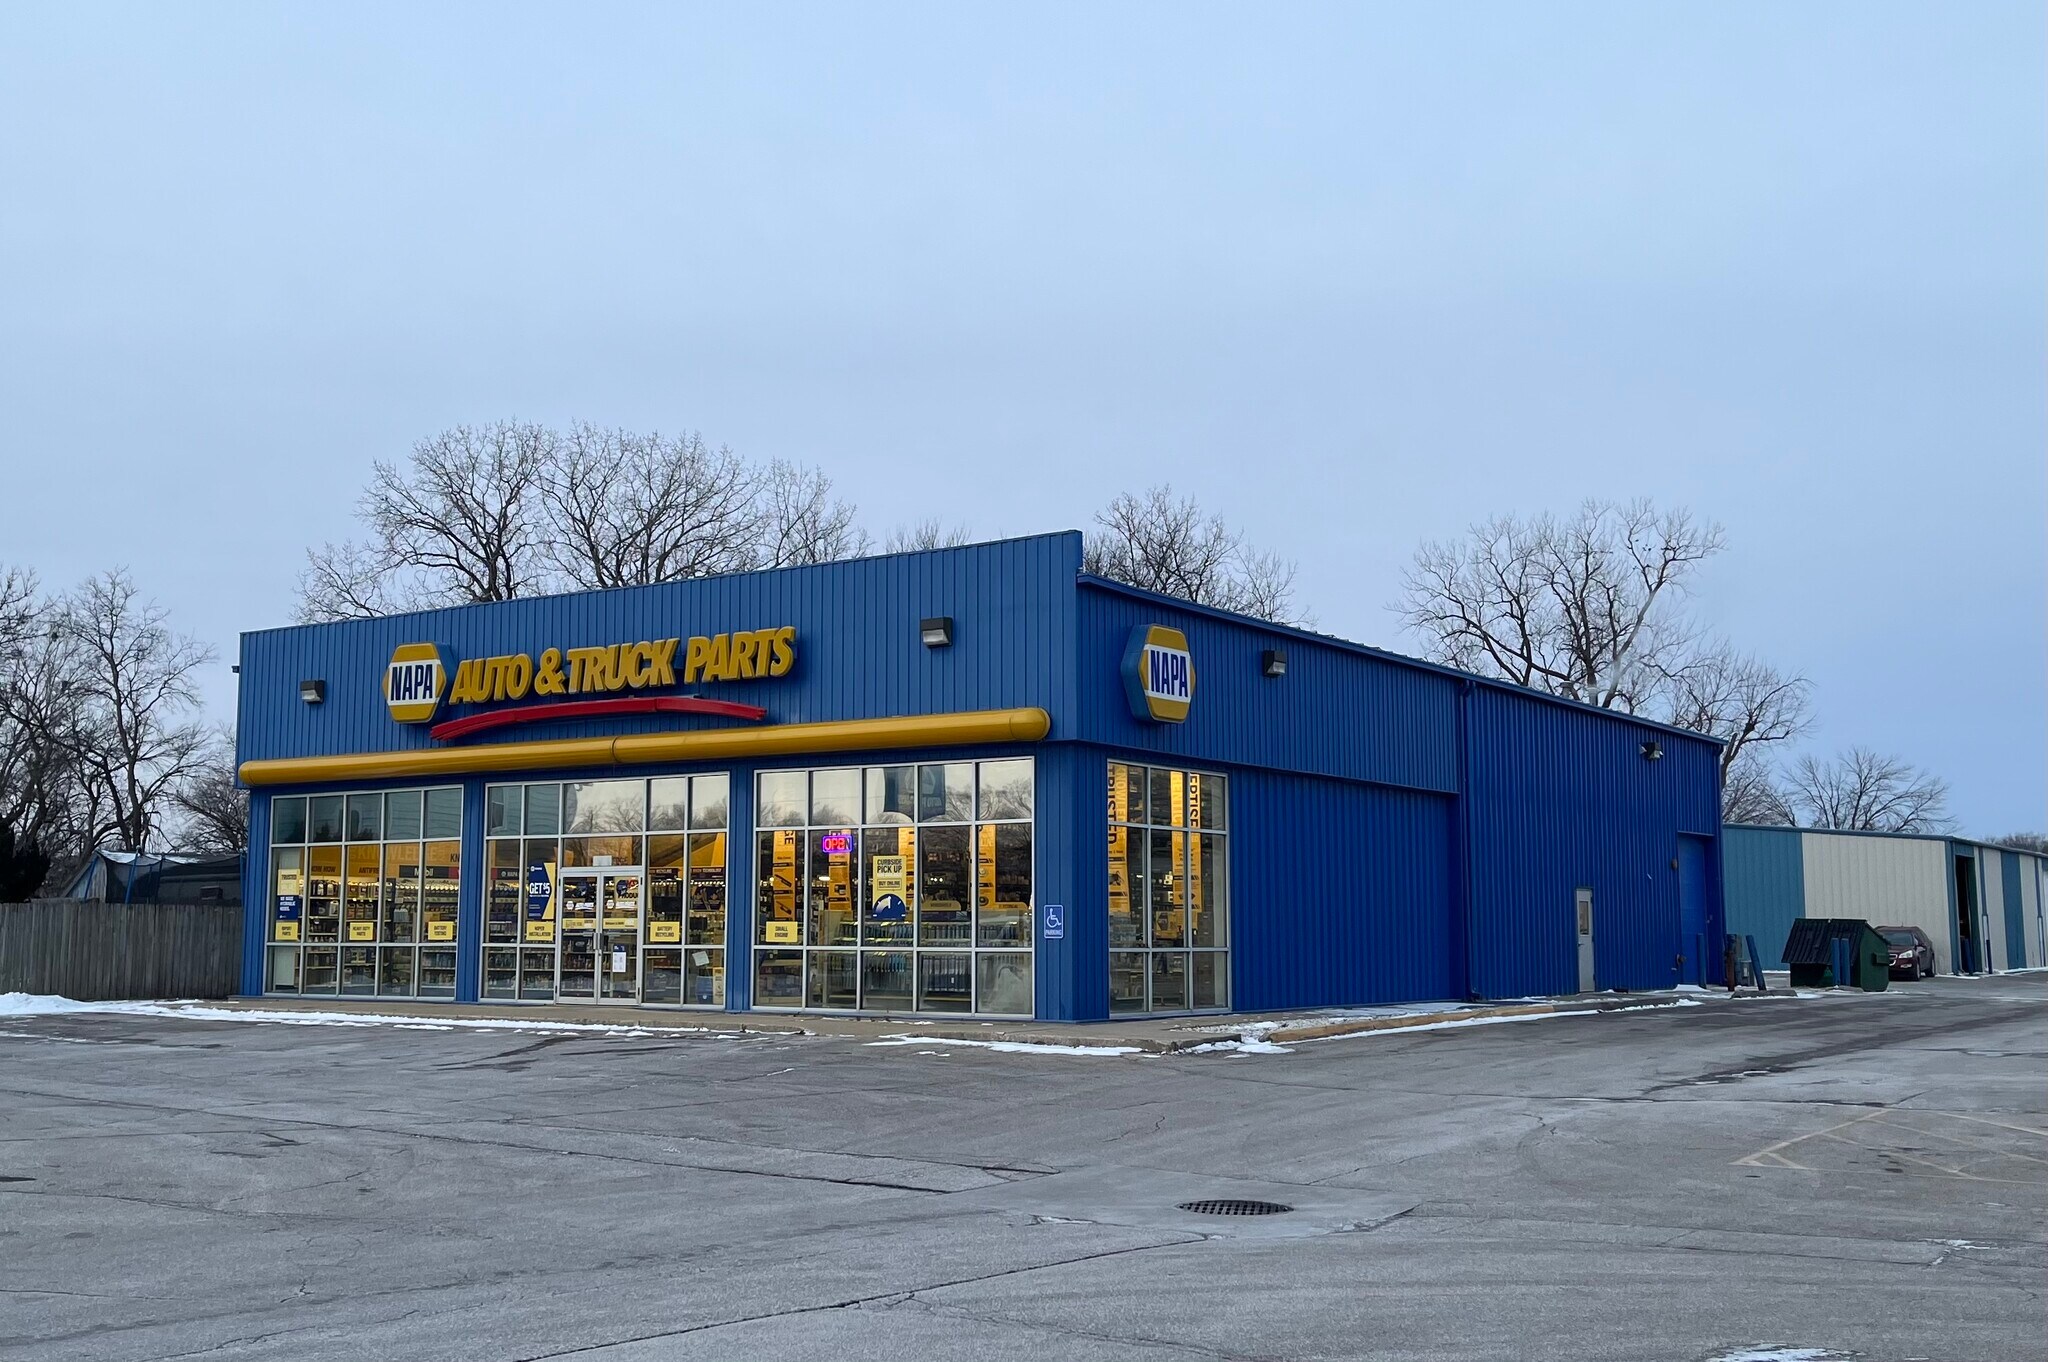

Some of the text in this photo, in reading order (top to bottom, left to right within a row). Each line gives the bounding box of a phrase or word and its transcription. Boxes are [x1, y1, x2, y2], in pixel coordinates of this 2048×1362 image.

[449, 626, 797, 705] AUTO & TRUCK PARTS
[1150, 650, 1188, 698] NAPA
[390, 664, 434, 701] NAPA
[824, 837, 850, 850] OPEN
[877, 865, 902, 873] PICK UP
[529, 882, 551, 894] GET $5
